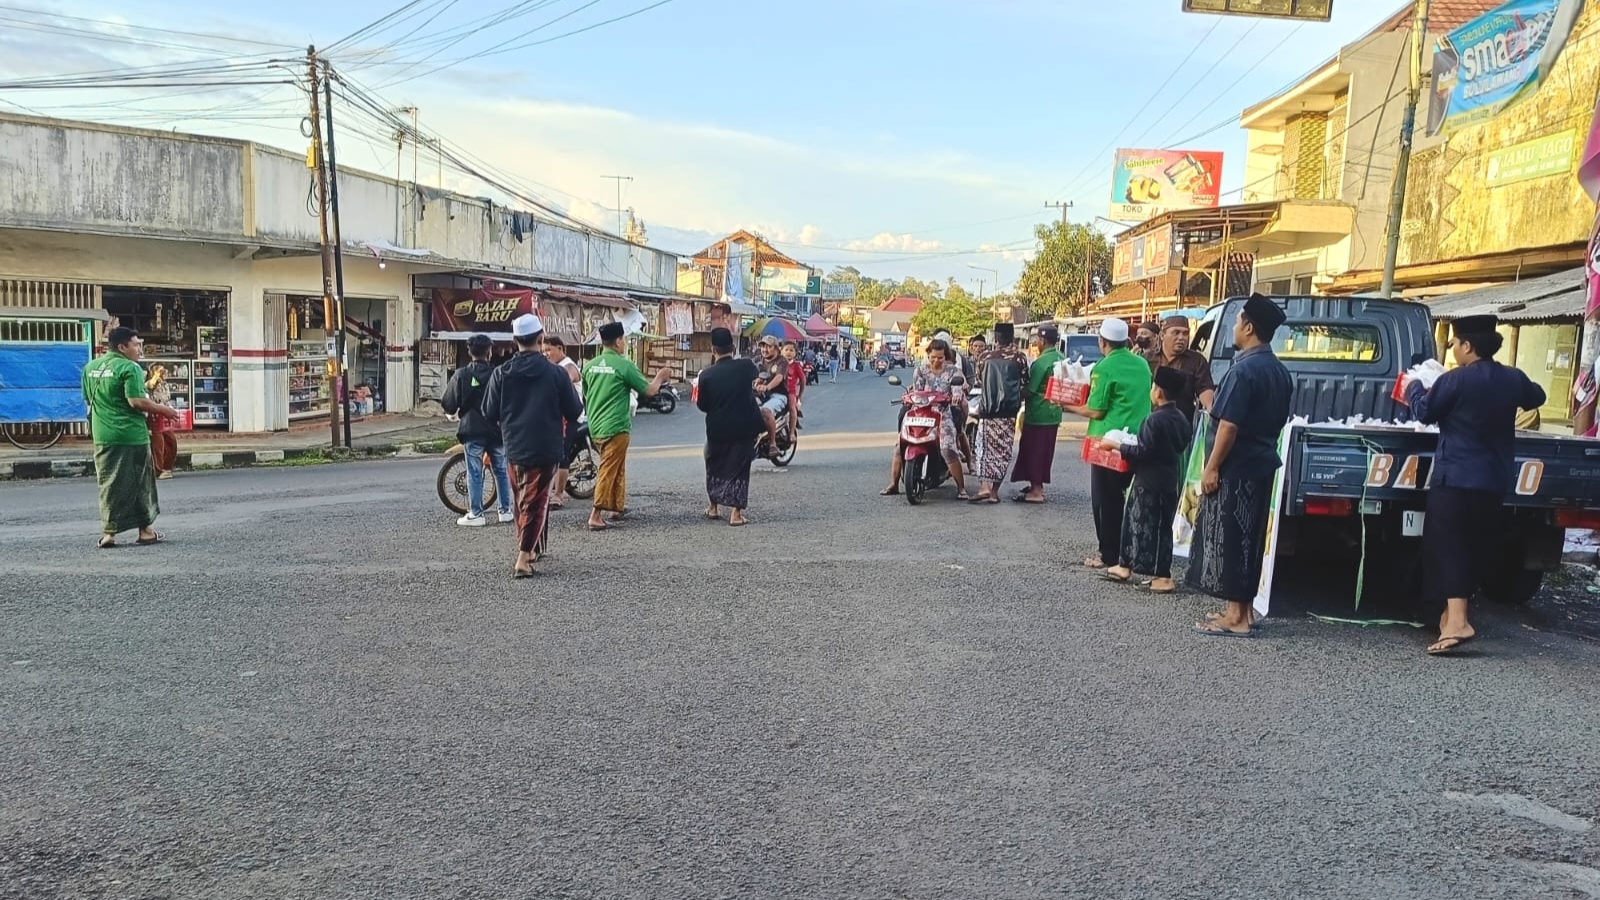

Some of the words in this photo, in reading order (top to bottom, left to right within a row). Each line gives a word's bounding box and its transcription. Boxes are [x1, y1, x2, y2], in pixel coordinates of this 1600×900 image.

[1501, 147, 1536, 167] JAMU
[1540, 137, 1573, 158] JAGO
[1122, 205, 1142, 213] TOKO
[474, 297, 521, 313] GAJAH
[474, 310, 512, 323] BARU
[1406, 513, 1415, 527] N
